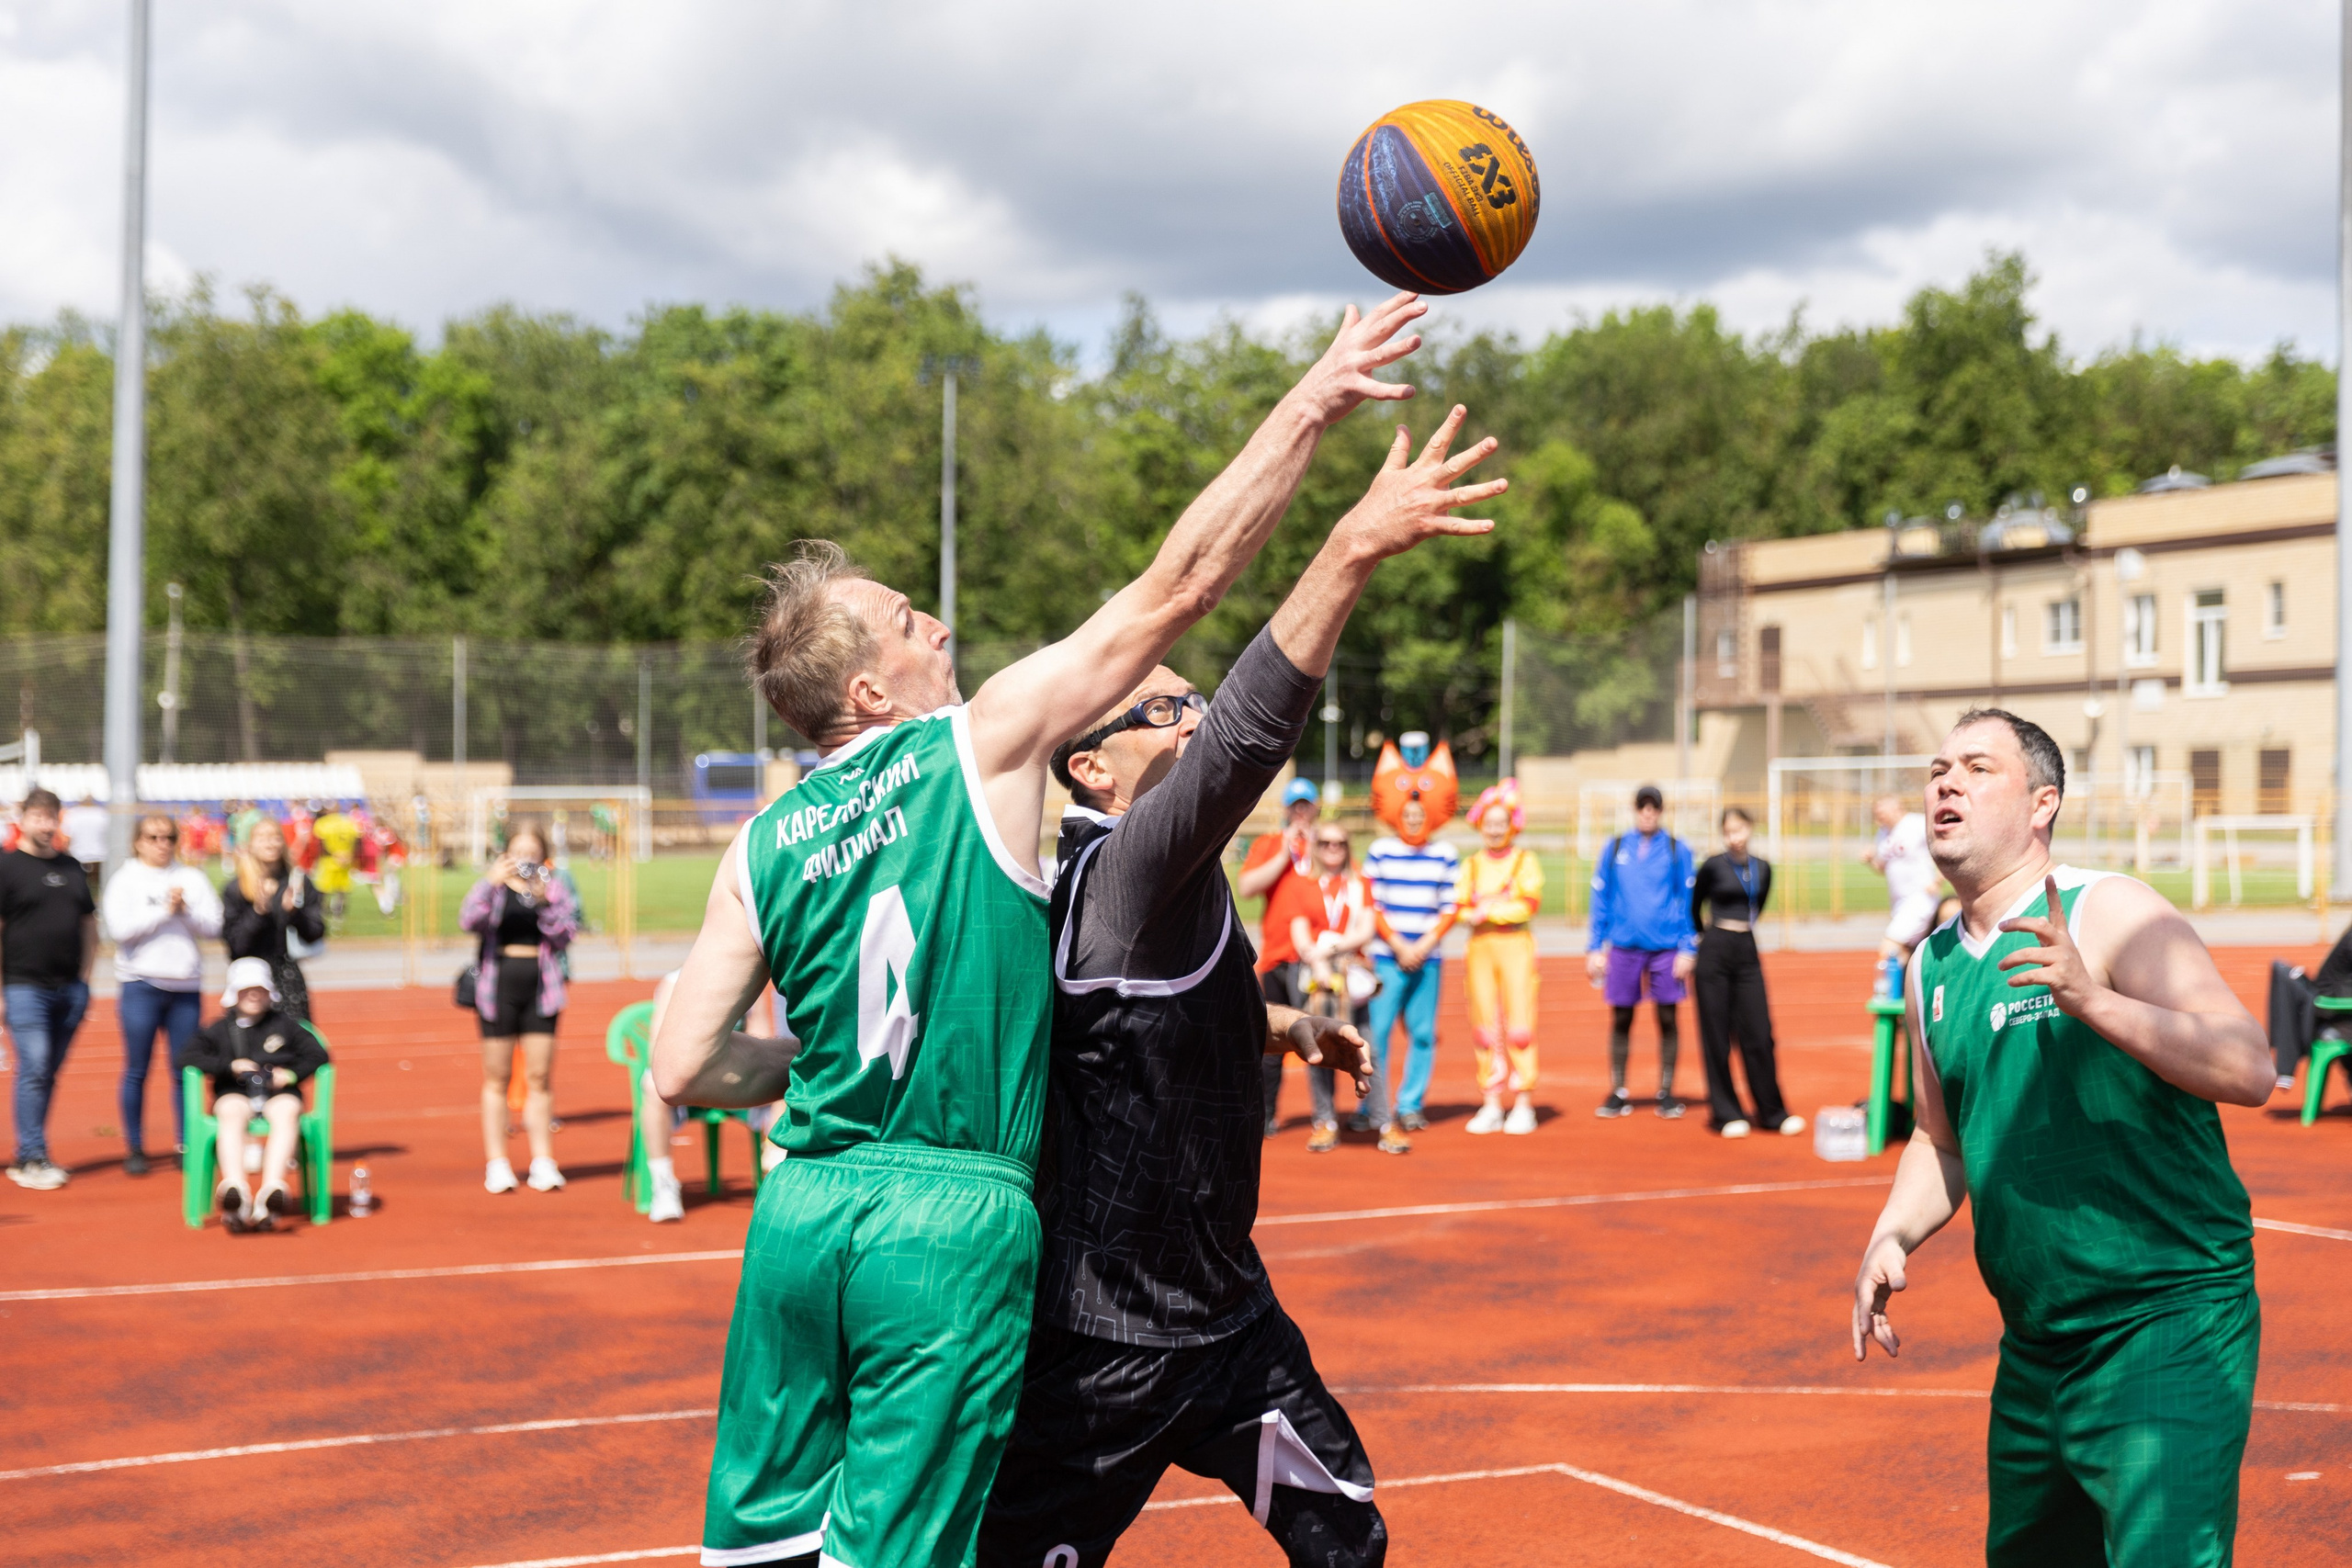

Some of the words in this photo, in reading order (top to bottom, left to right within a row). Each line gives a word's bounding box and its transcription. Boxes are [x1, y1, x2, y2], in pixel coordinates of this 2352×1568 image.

[1443, 162, 1470, 198] OFFICIAL
[1467, 197, 1480, 217] BALL
[1458, 166, 1475, 186] FIBA
[776, 752, 921, 849] КАРЕЛЬСКИЙ
[802, 806, 908, 884] ФИЛИАЛ
[2008, 1008, 2060, 1026] СЕВЕРО-ЗАПАД
